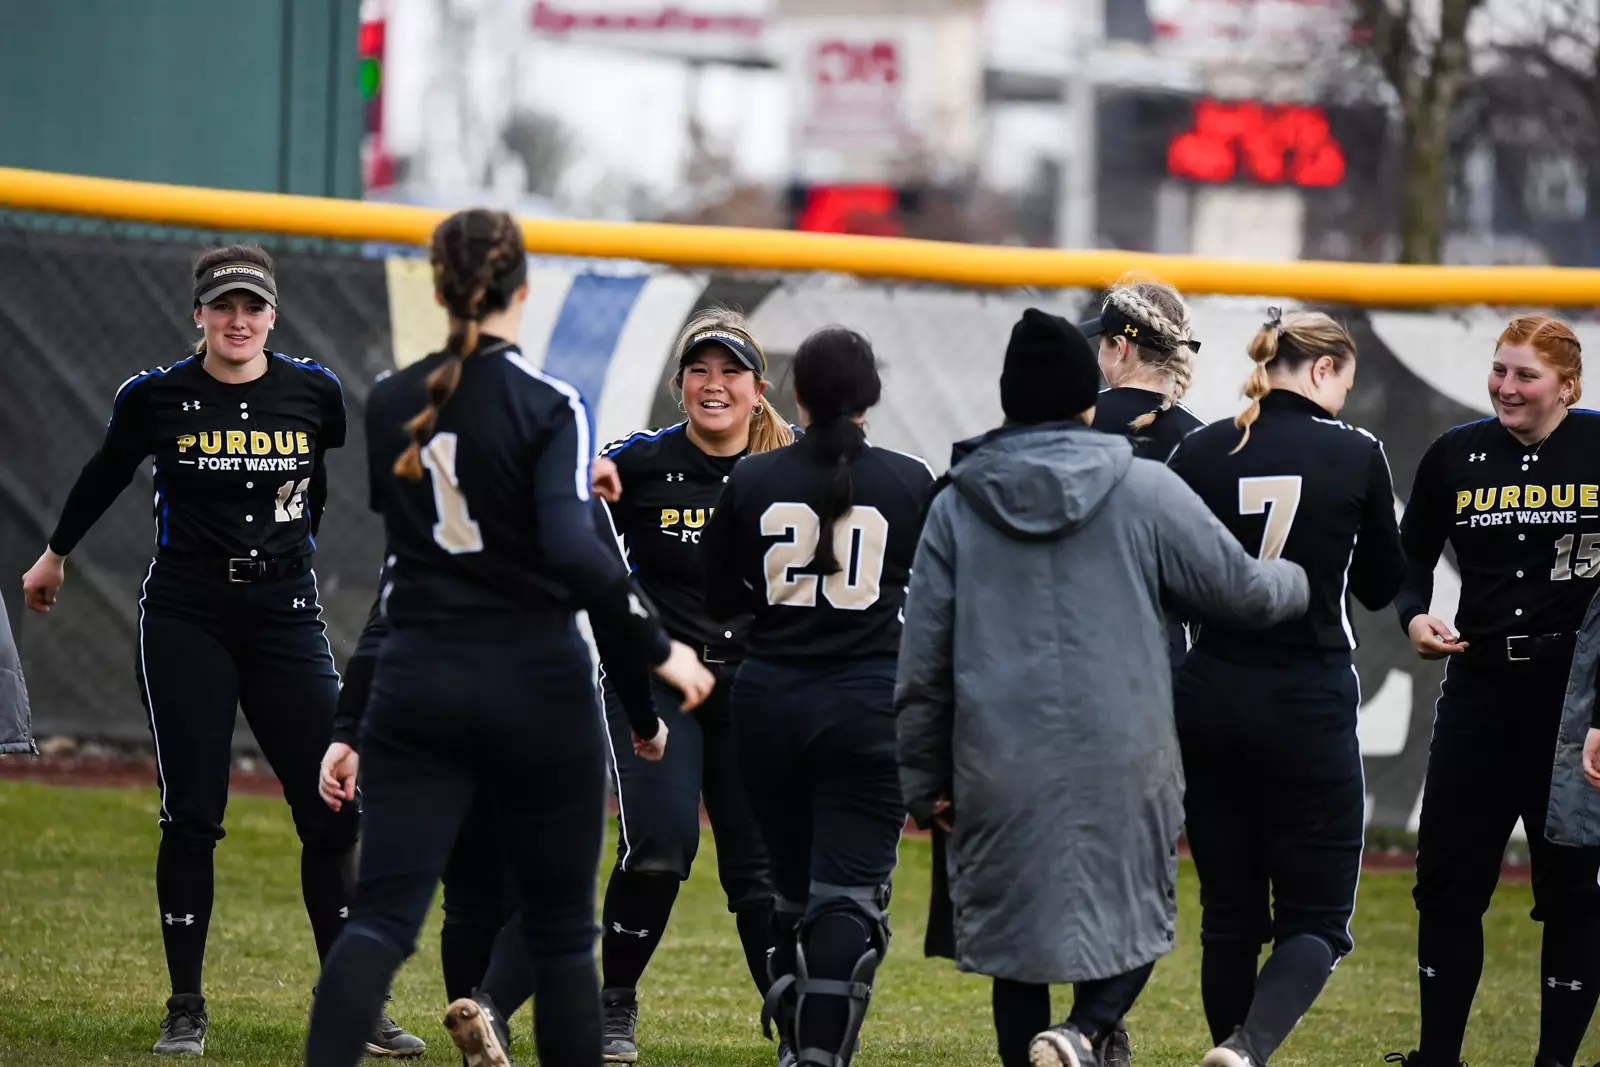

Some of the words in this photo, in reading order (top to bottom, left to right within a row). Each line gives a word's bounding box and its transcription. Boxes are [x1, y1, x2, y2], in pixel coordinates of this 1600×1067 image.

[177, 430, 310, 455] PURDUE
[198, 457, 242, 471] FORT
[244, 457, 298, 471] WAYNE
[420, 431, 484, 554] 1
[1456, 484, 1600, 514] PURDUE
[1238, 475, 1303, 561] 7
[1470, 511, 1514, 528] FORT
[1516, 510, 1577, 524] WAYNE
[760, 502, 889, 610] 20
[1551, 532, 1600, 581] 15
